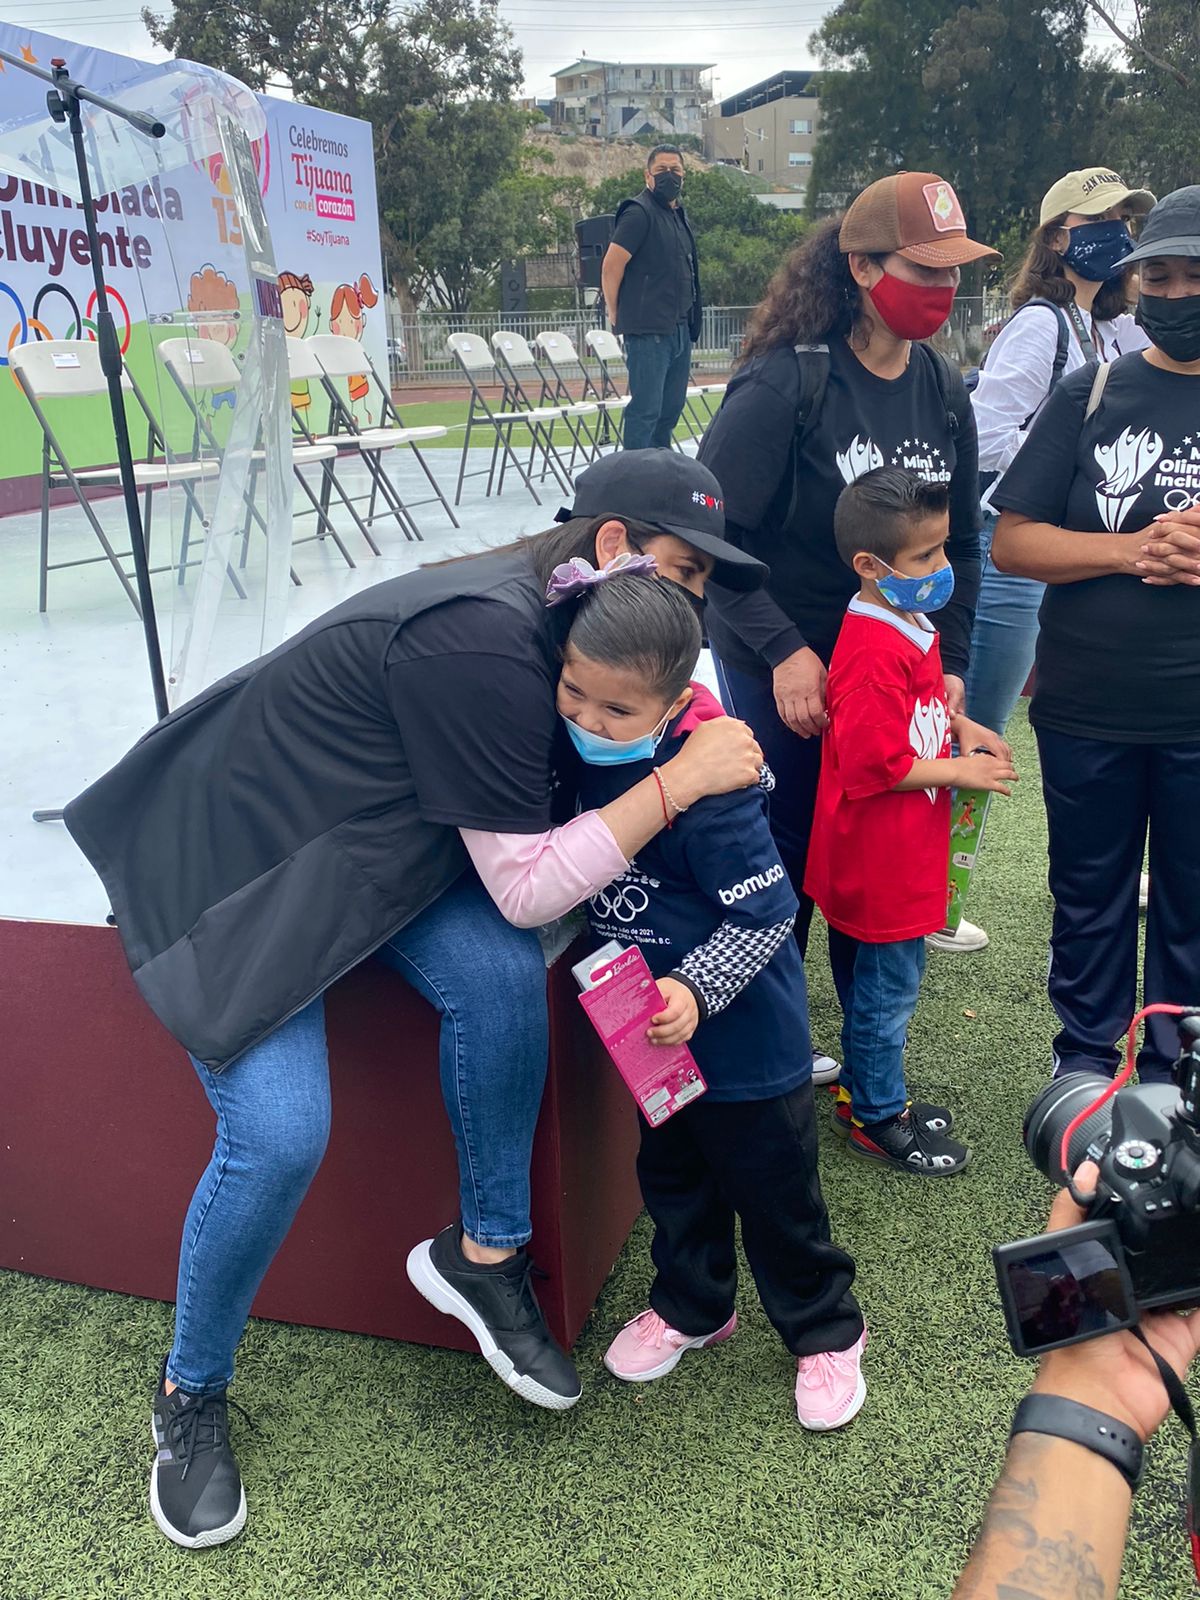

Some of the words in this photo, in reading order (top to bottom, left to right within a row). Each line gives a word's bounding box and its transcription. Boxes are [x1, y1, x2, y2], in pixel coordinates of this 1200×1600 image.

[289, 125, 349, 158] Celebremos
[291, 152, 353, 196] Tijuana
[1082, 176, 1098, 196] SAN
[294, 199, 306, 210] con
[307, 198, 314, 212] el
[318, 199, 353, 217] corazón
[0, 210, 152, 276] luyente
[306, 229, 350, 247] #SoyTijuana
[903, 454, 933, 469] Mini
[630, 927, 638, 935] de
[639, 928, 654, 936] 2021
[658, 937, 672, 945] B.C.
